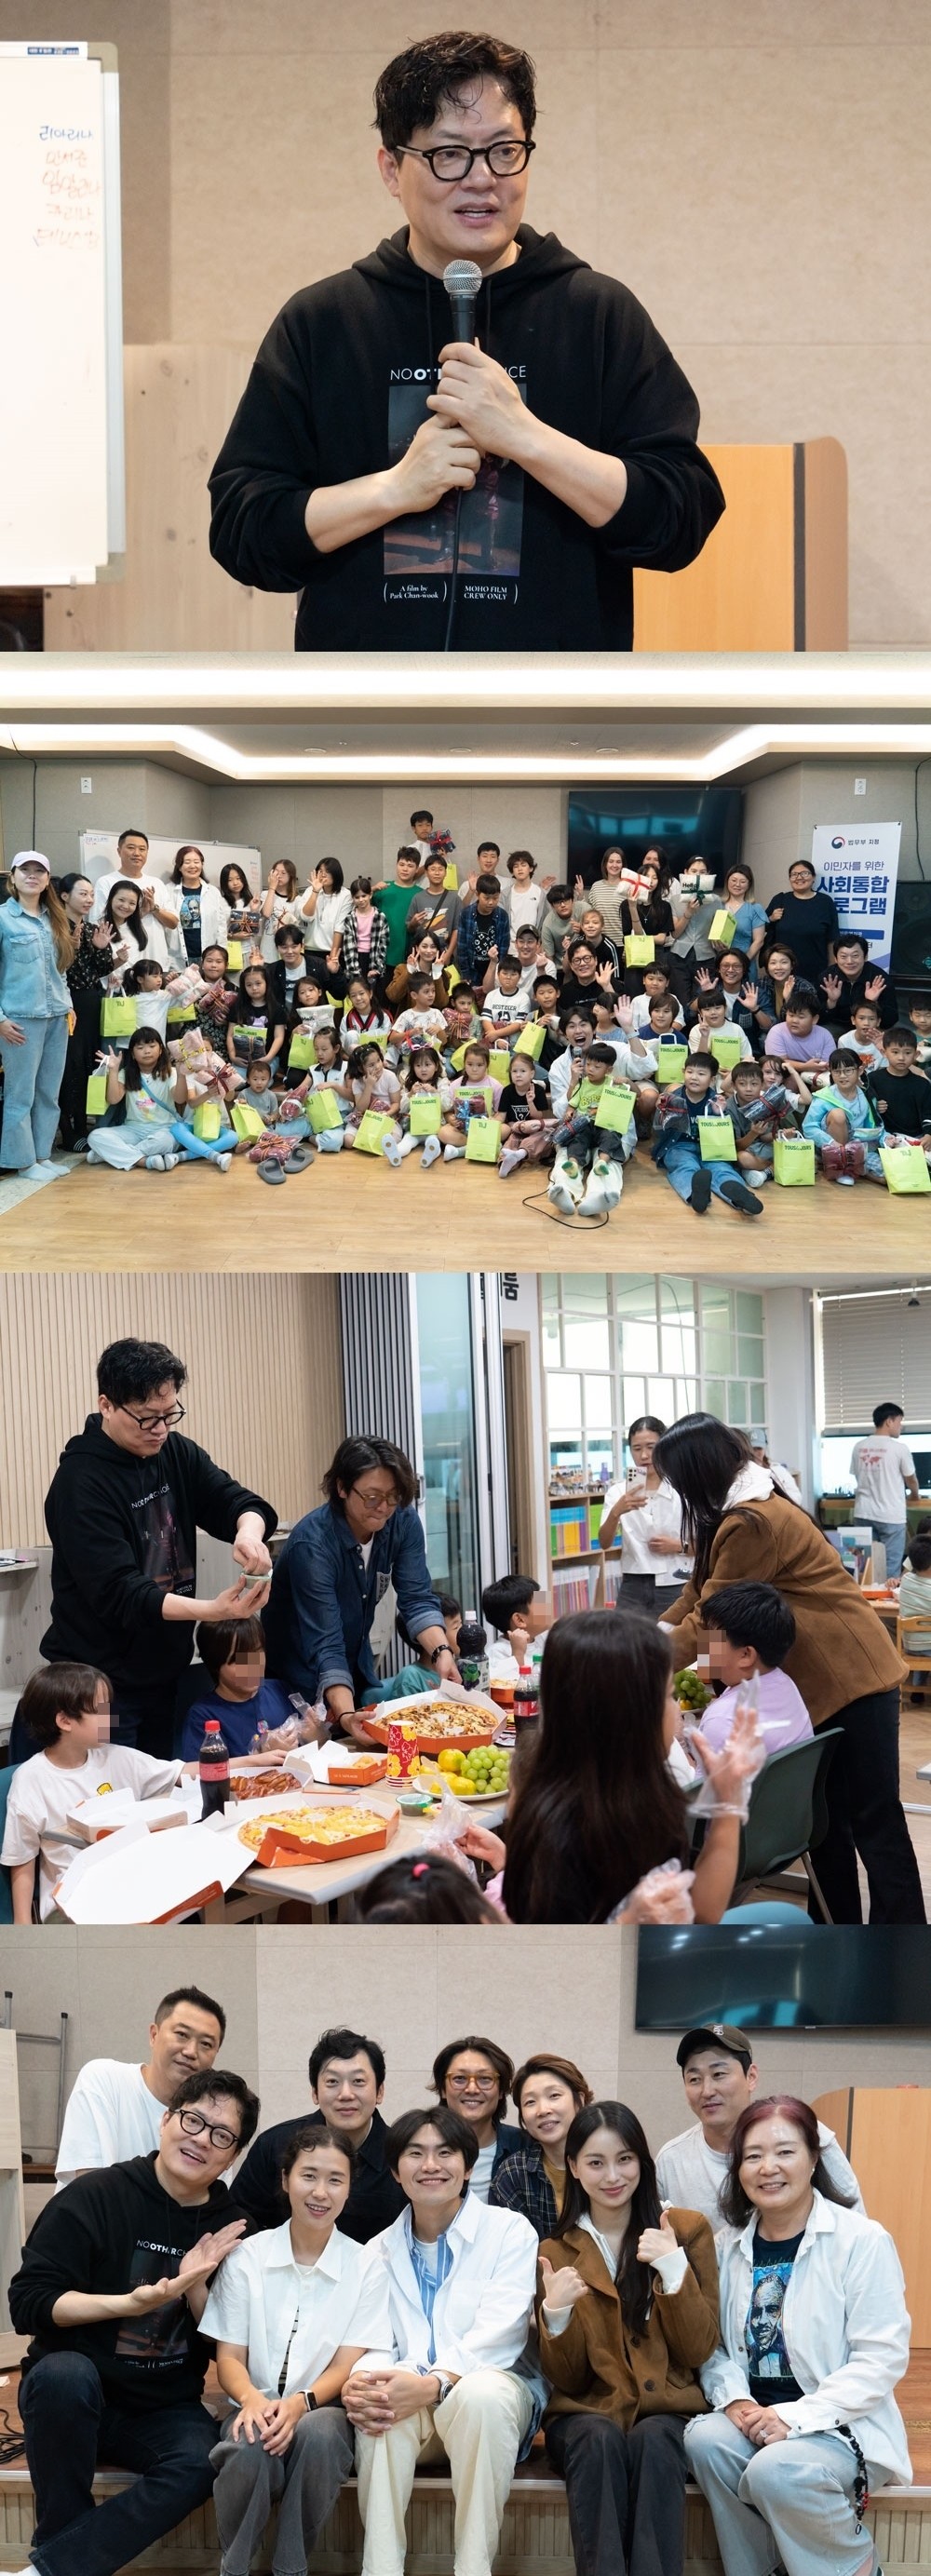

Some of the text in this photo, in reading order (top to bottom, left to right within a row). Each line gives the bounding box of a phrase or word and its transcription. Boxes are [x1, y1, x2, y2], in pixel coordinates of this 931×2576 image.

[823, 860, 884, 871] 이민자를 위한
[816, 875, 889, 894] 사회통합
[835, 897, 887, 915] 로그램
